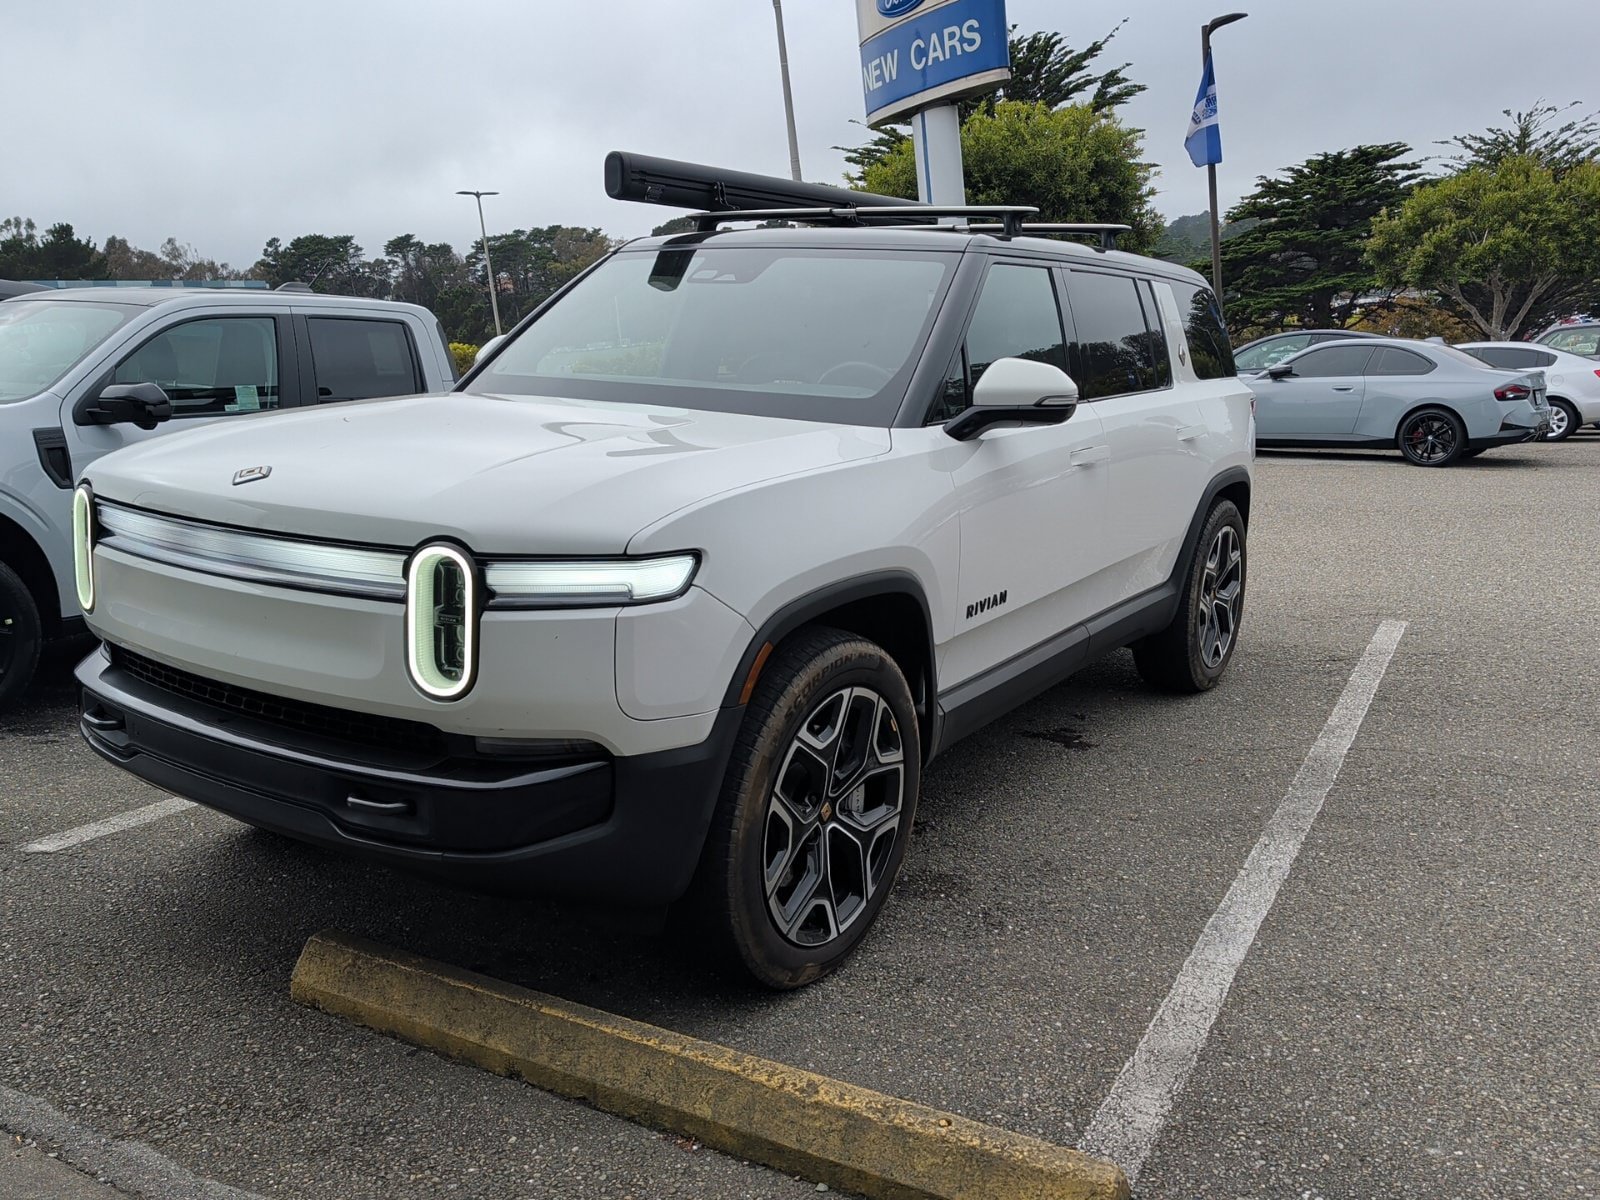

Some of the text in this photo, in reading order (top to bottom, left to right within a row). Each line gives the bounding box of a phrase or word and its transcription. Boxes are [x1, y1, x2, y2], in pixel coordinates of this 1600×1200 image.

[863, 19, 982, 94] NEW CARS
[966, 589, 1008, 620] RIVIAN
[784, 653, 853, 721] SCORPION
